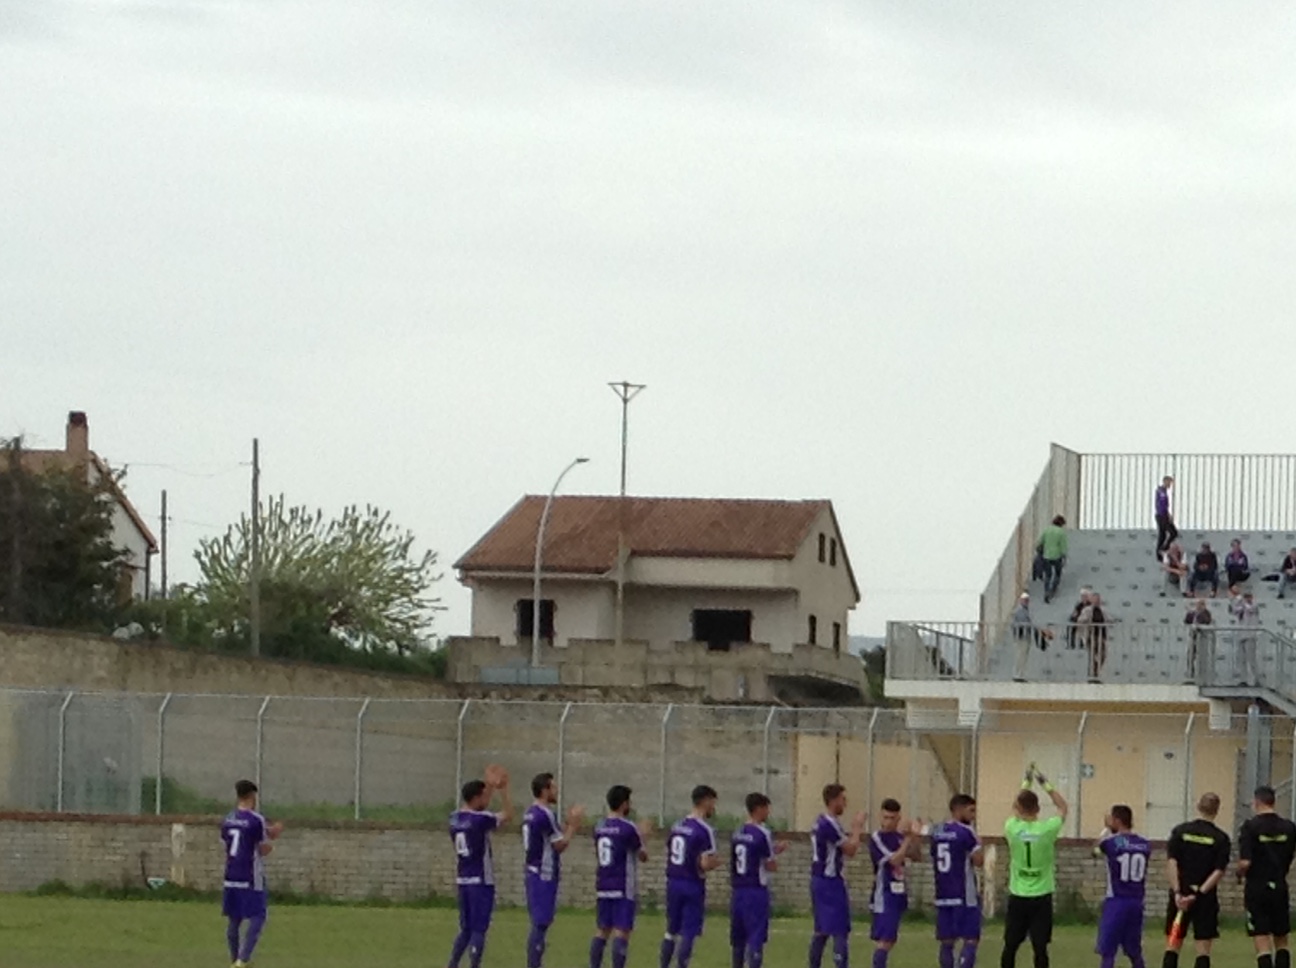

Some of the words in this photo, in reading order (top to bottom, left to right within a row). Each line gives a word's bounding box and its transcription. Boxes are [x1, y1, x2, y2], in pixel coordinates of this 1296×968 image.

[228, 829, 240, 857] 7
[597, 836, 612, 866] 6
[670, 836, 685, 865] 9
[937, 843, 951, 872] 5
[1024, 841, 1032, 868] 1
[735, 844, 746, 874] 3
[1117, 852, 1146, 882] 10
